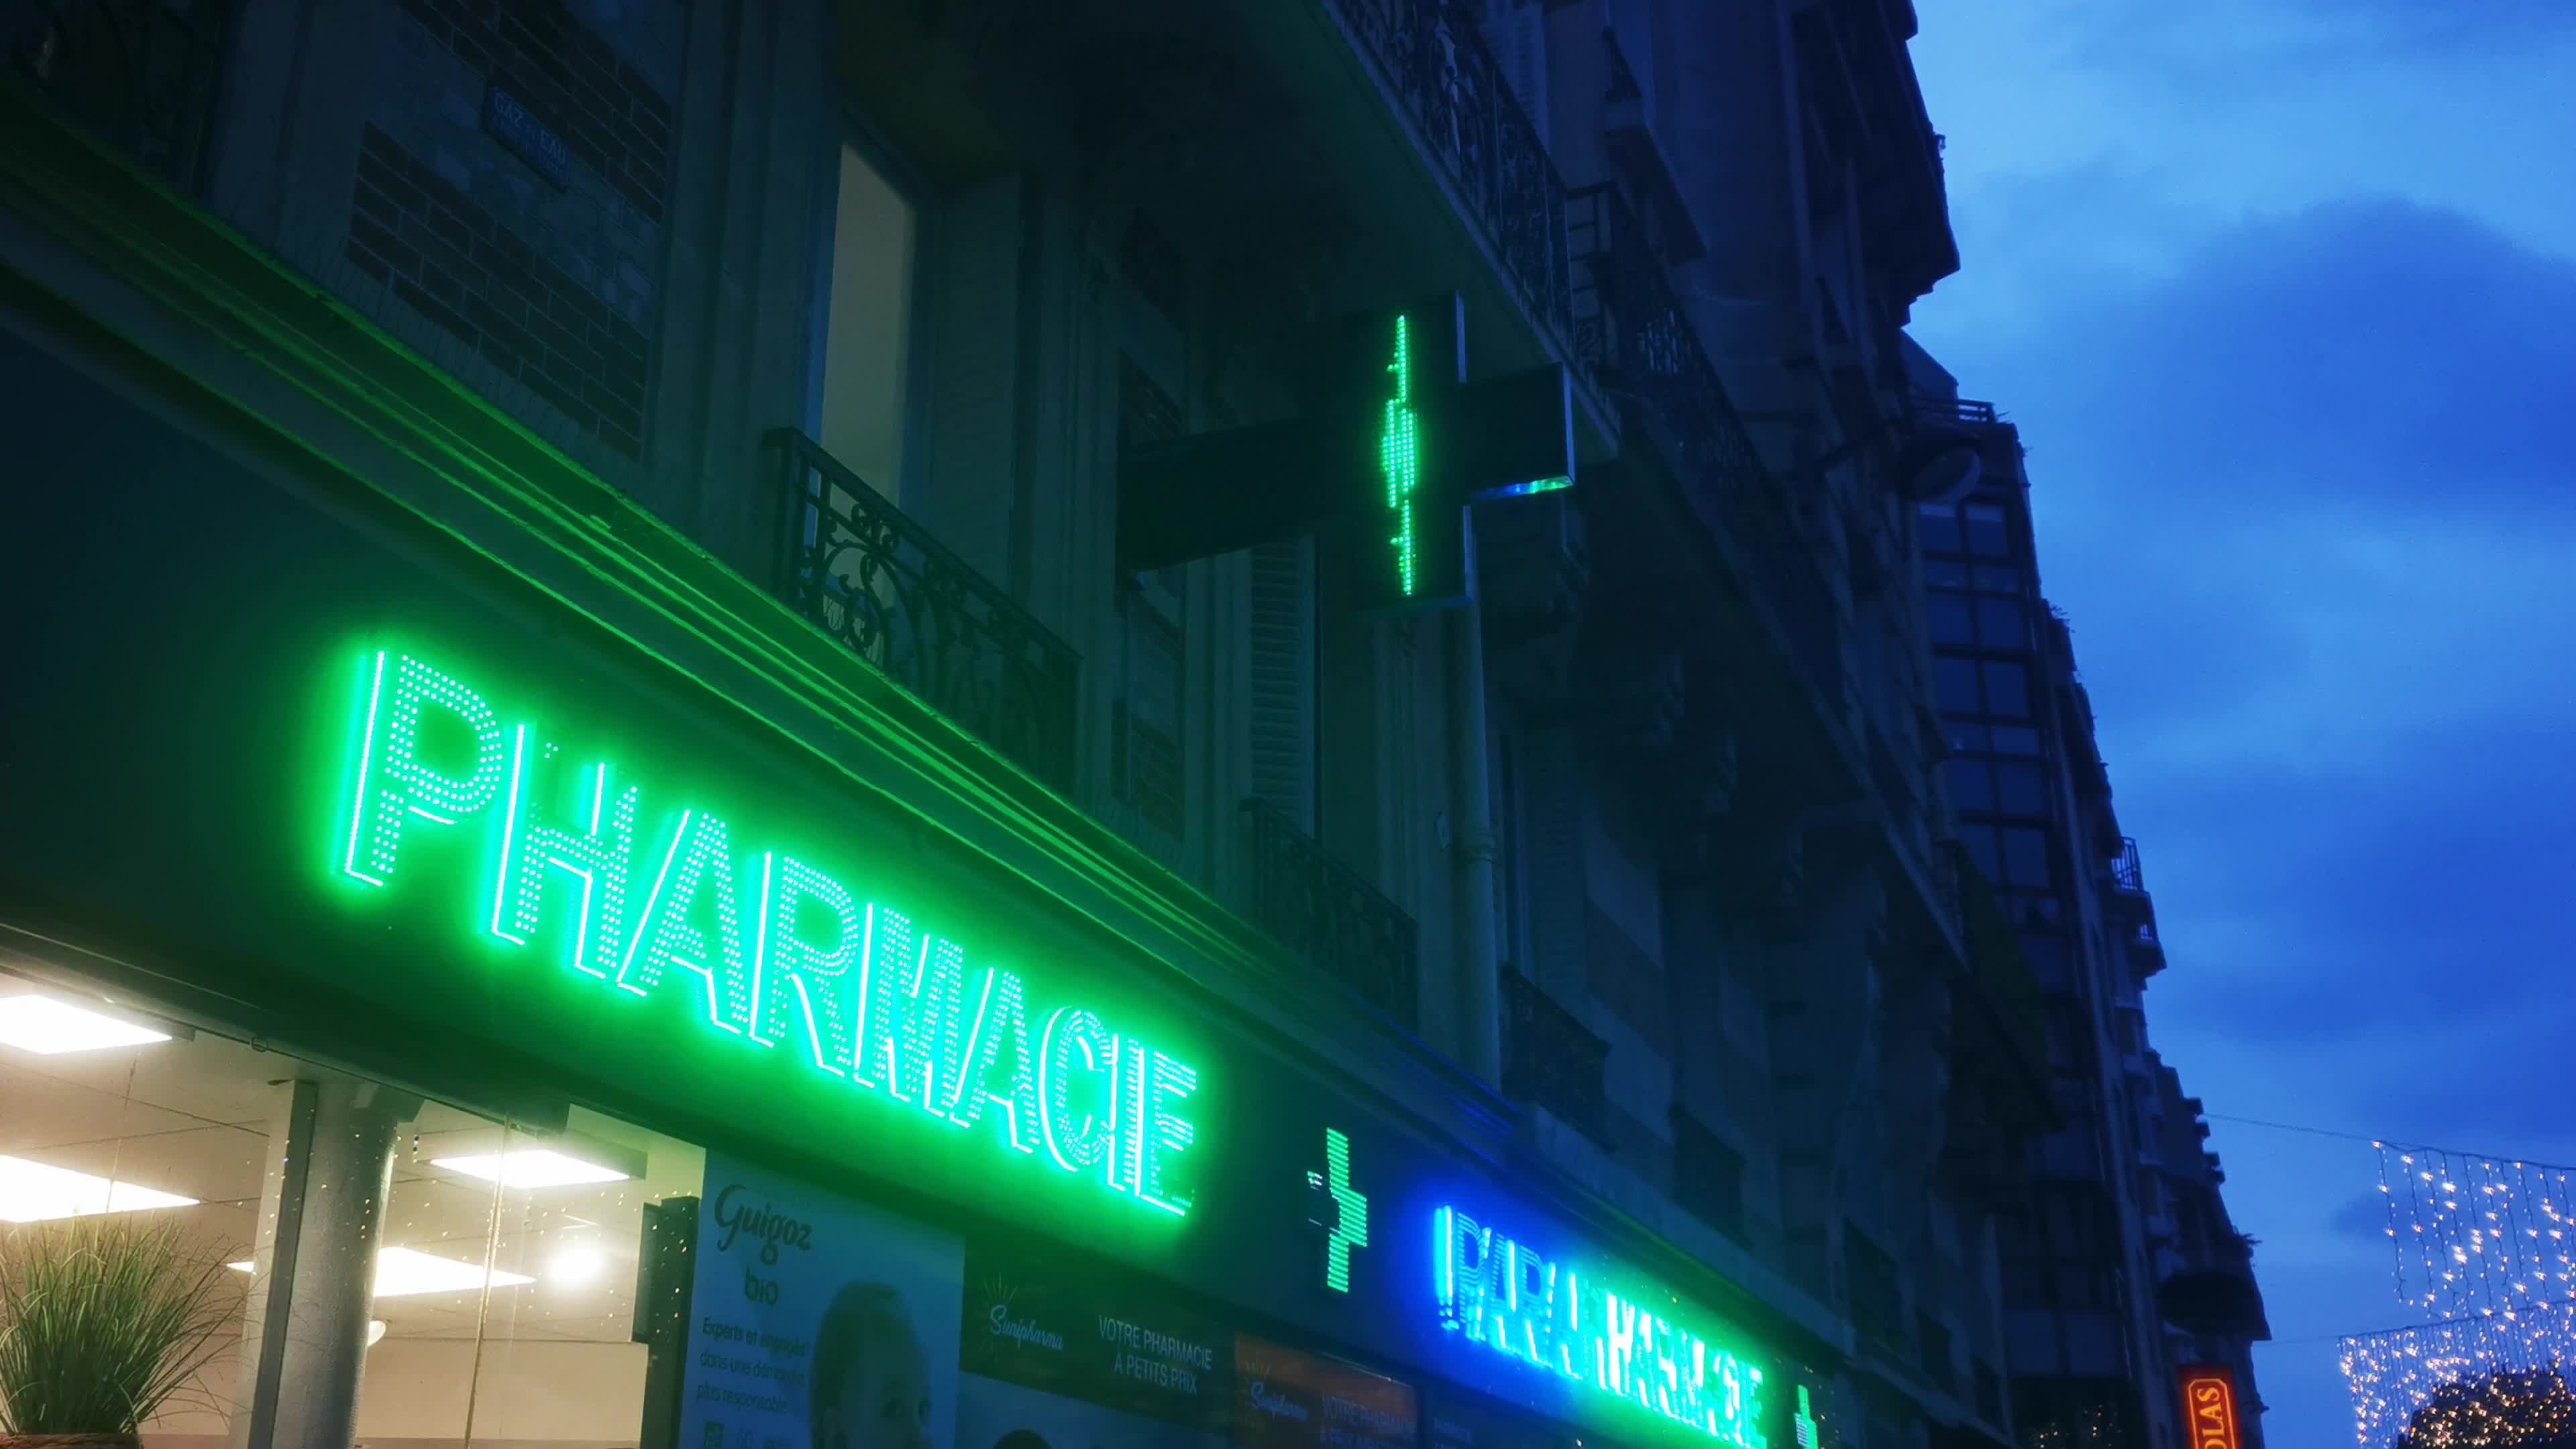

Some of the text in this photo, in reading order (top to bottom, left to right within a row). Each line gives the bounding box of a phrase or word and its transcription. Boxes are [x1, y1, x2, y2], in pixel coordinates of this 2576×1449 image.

[341, 649, 1197, 1216] PHARMACIE
[715, 1184, 812, 1265] Guigoz
[745, 1267, 779, 1306] bio
[703, 1318, 743, 1342] Experts
[1098, 1314, 1212, 1370] VOTRE PHARMACIE
[1126, 1353, 1167, 1386] PETITS
[1171, 1368, 1197, 1395] PRIX
